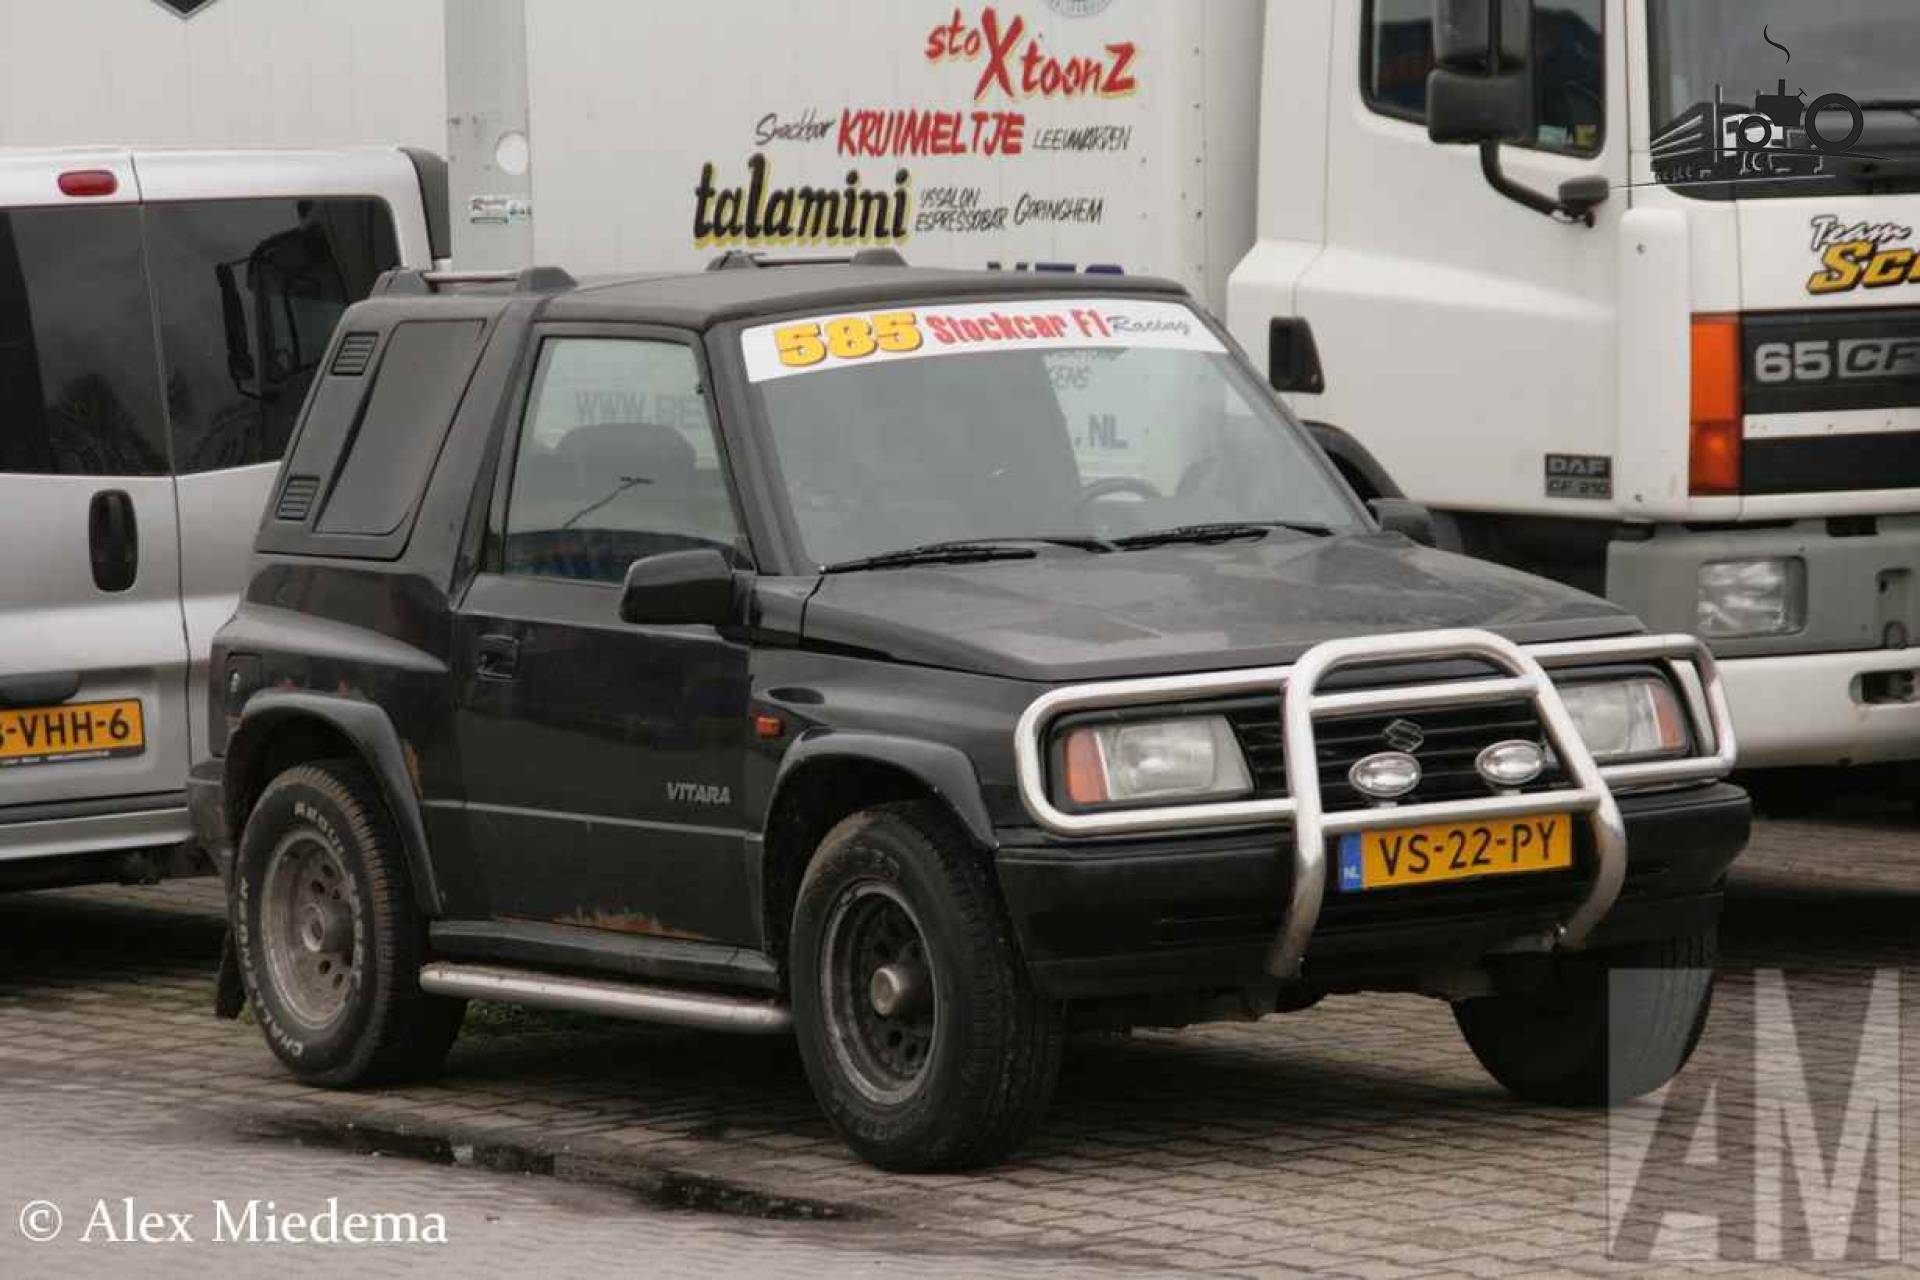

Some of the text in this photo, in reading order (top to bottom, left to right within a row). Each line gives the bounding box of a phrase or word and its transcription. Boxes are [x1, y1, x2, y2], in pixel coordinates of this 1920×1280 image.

[837, 109, 1025, 156] KRUIMELTJE
[694, 153, 911, 238] talamini
[773, 309, 1190, 367] 585 Stockcar F1 Racing
[1755, 339, 1920, 382] 65 CF
[1549, 458, 1606, 474] DAF
[0, 708, 130, 747] -VHH-6
[667, 781, 730, 804] VITARA
[1379, 821, 1556, 876] VS-22-PY
[1343, 866, 1360, 879] NL
